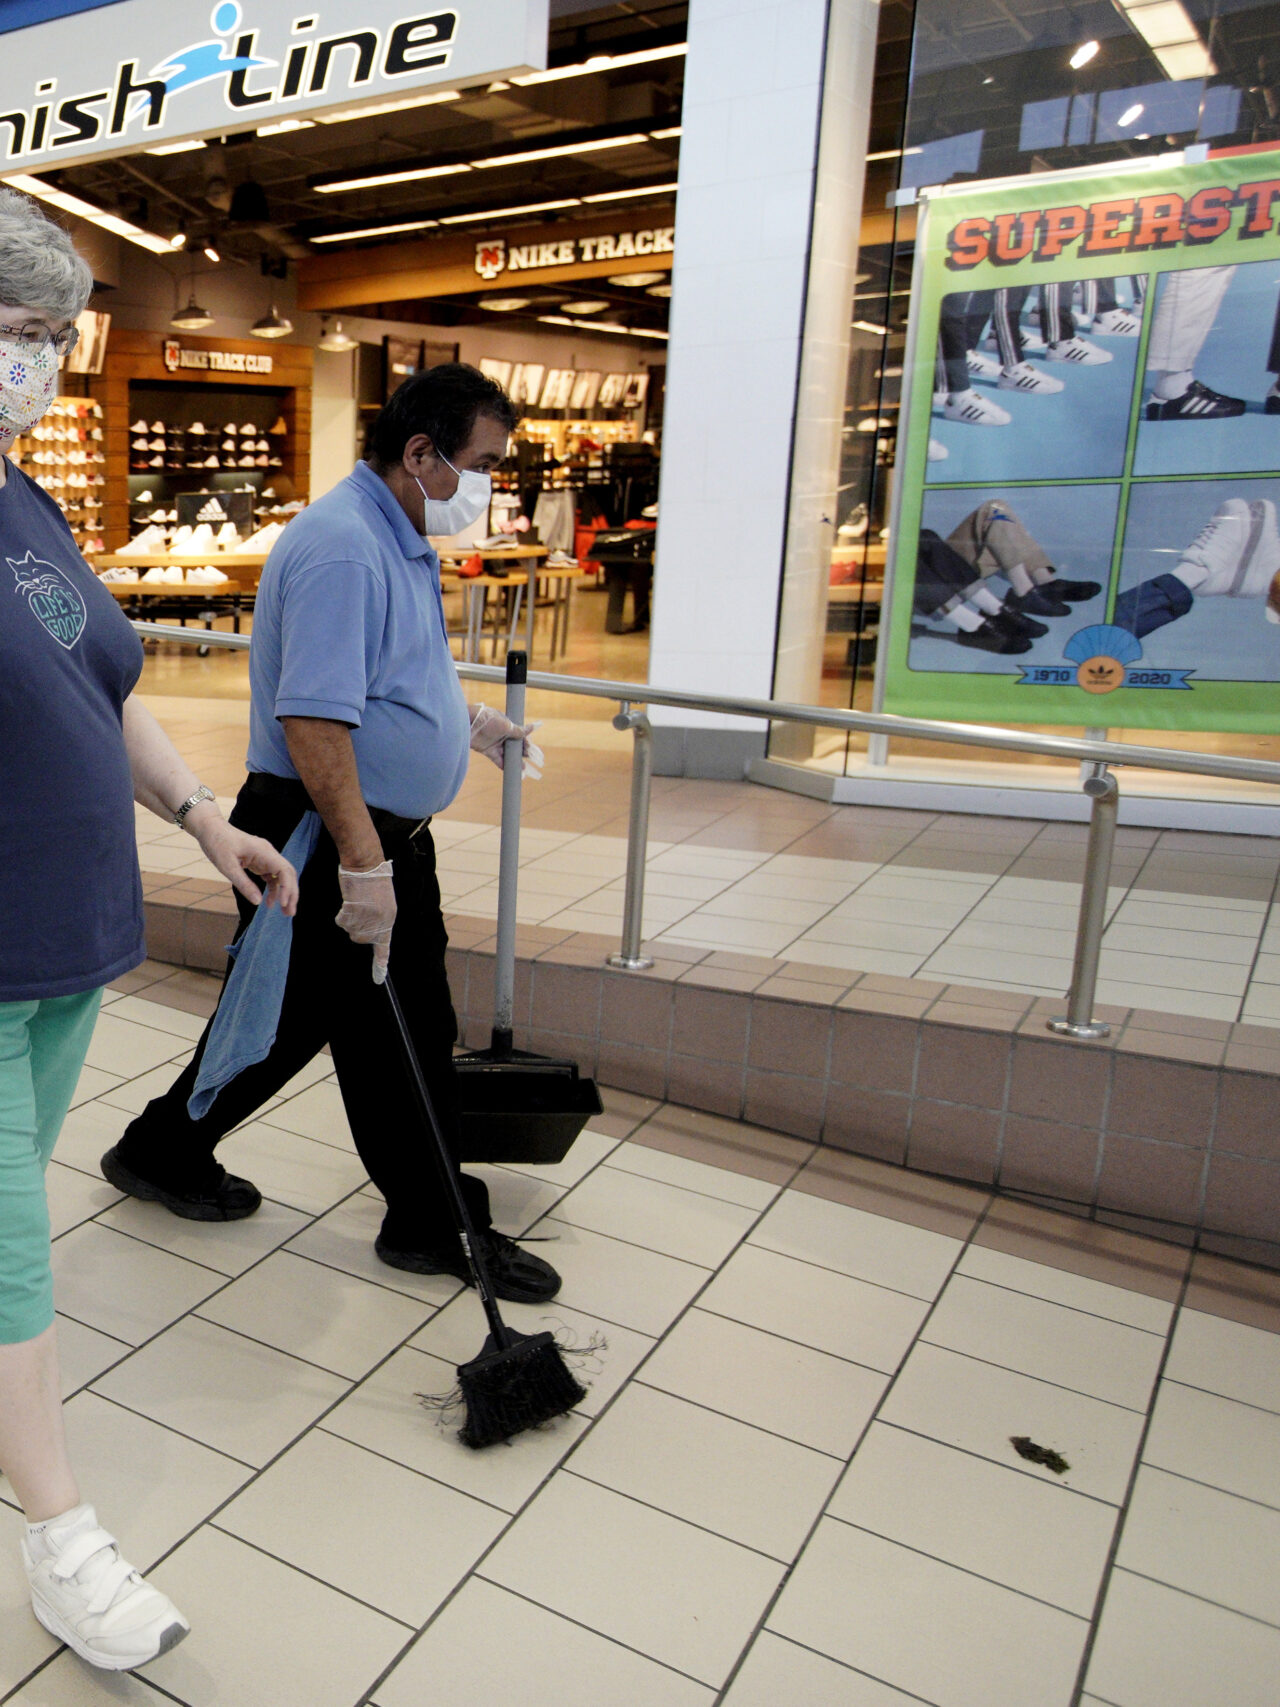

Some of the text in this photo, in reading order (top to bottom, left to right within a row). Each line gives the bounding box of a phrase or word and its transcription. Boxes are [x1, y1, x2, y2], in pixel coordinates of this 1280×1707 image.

[944, 178, 1280, 271] SUPERST
[508, 226, 675, 271] NIKE TRACK
[209, 351, 246, 372] TRACK
[246, 354, 273, 374] CLUB
[32, 589, 68, 619] LIFE
[46, 613, 83, 641] GOOD
[1033, 669, 1171, 686] 1970 2020
